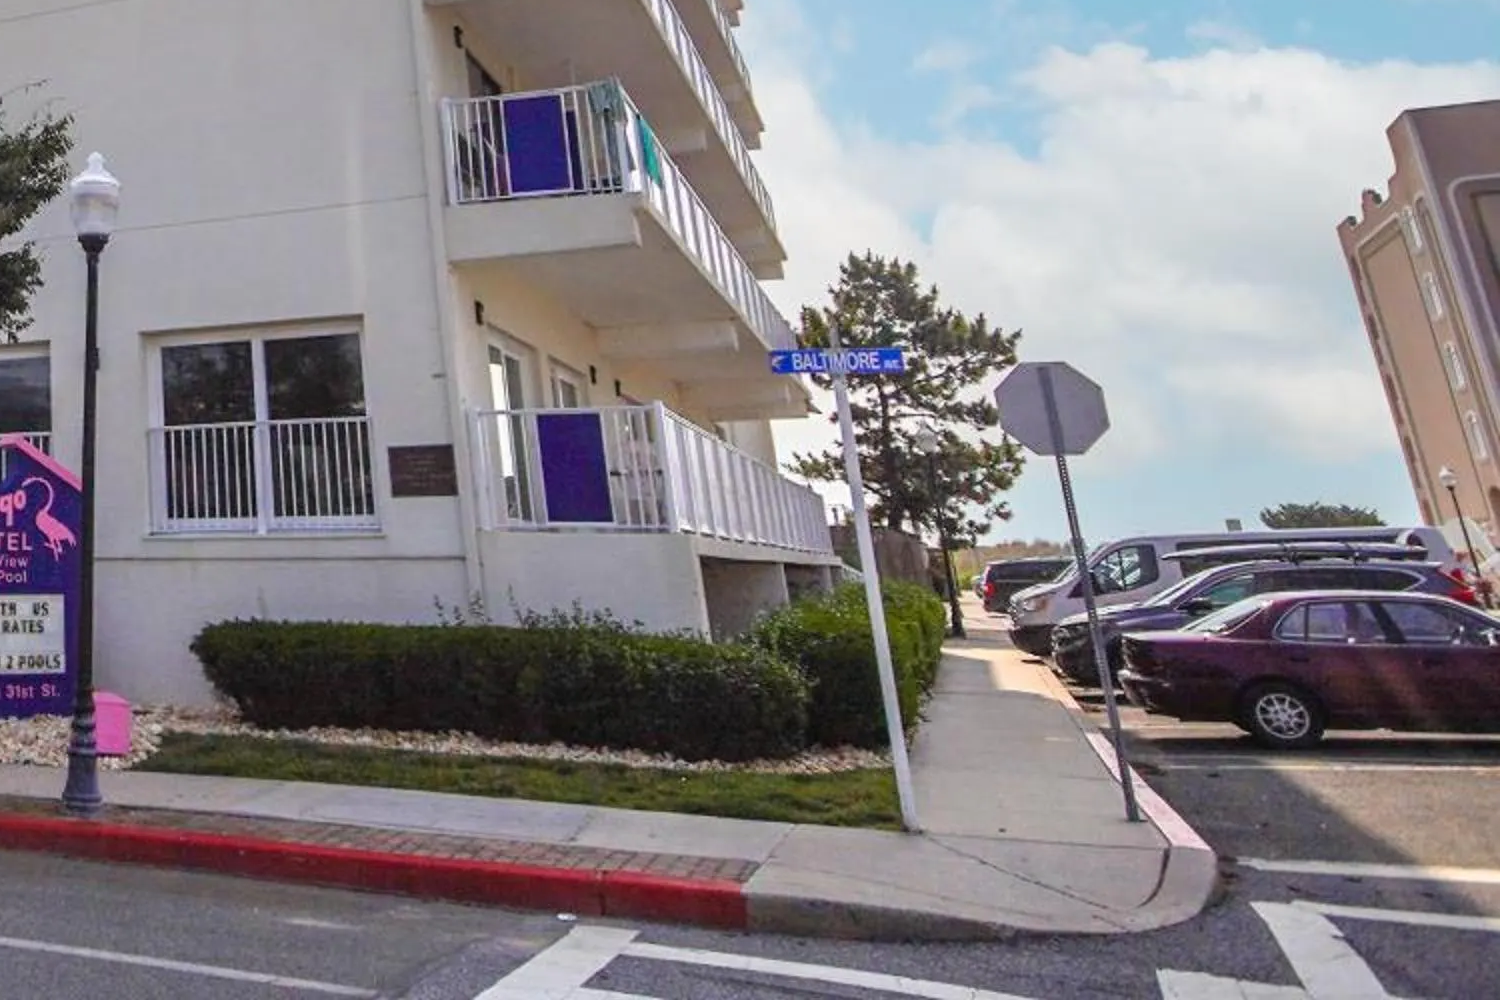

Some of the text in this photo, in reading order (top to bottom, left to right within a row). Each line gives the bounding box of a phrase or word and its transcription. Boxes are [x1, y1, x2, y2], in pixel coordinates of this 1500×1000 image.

[791, 351, 880, 371] BALTIMORE
[32, 602, 49, 616] US
[2, 619, 45, 633] RATES
[6, 655, 14, 669] 2
[18, 654, 61, 669] POOLS
[5, 684, 35, 699] 31st
[40, 683, 60, 697] St.
